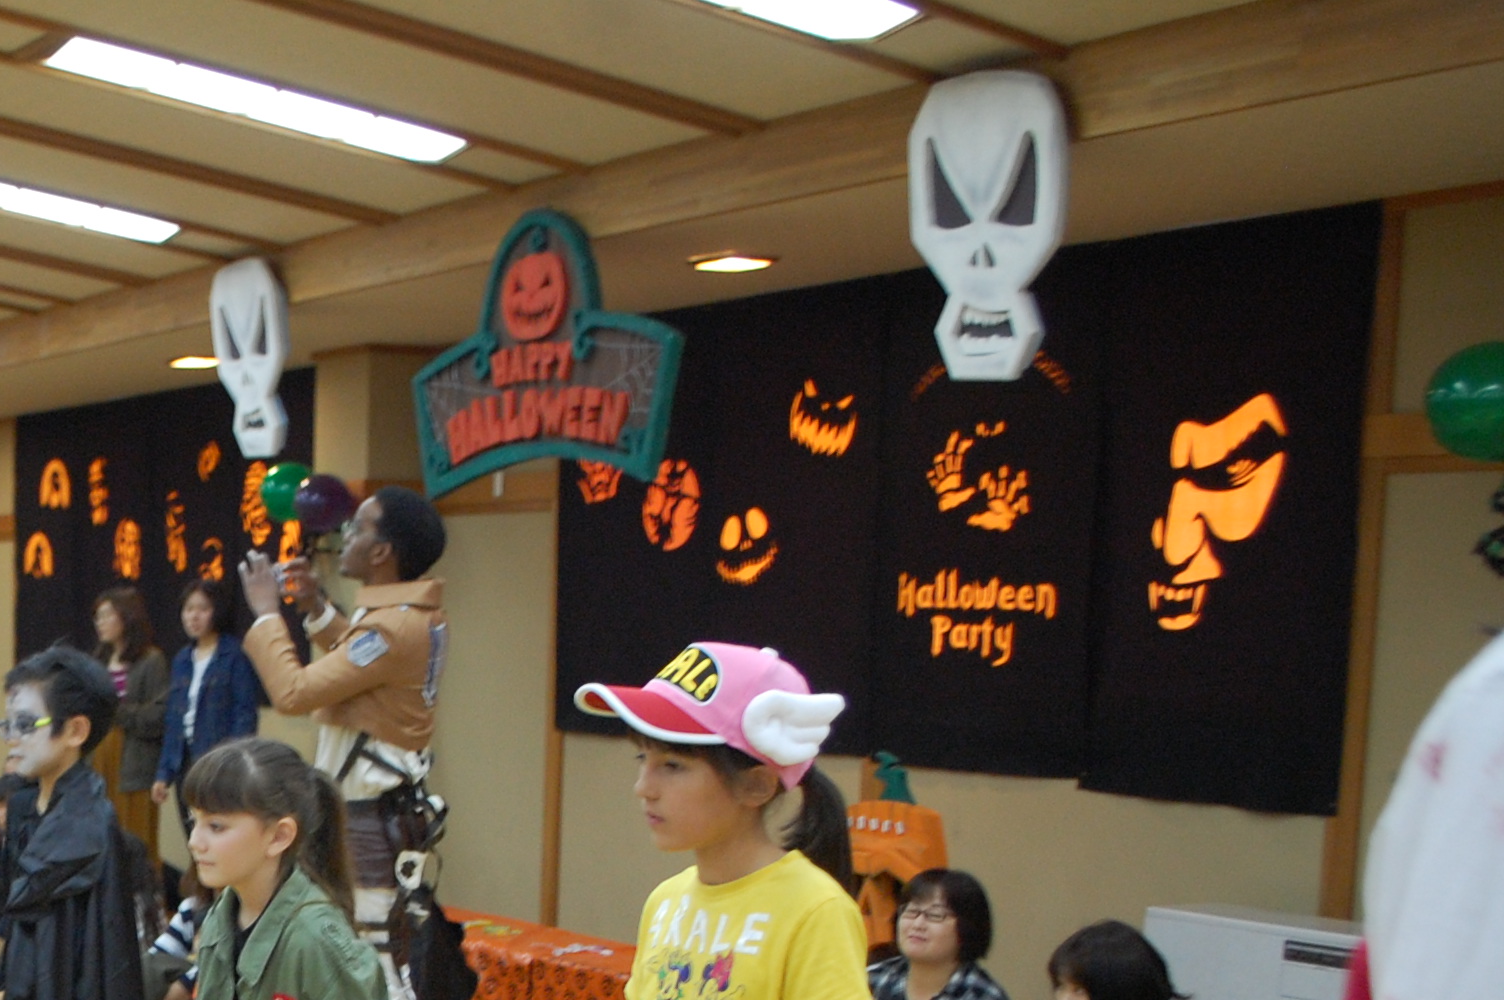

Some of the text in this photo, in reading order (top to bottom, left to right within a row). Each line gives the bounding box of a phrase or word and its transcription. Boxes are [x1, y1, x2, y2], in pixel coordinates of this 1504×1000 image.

[447, 386, 629, 465] HALLOWEEN
[897, 568, 1057, 619] Halloween
[930, 614, 1014, 667] Party
